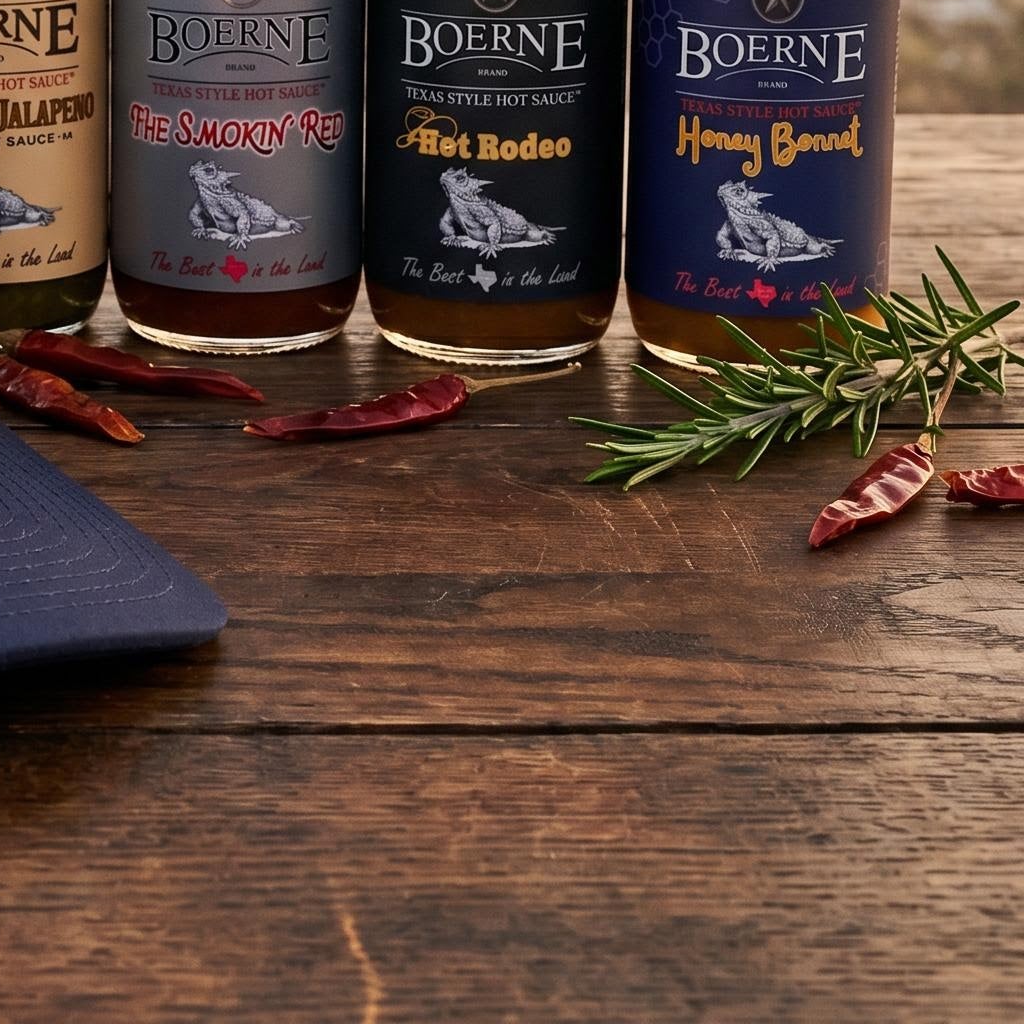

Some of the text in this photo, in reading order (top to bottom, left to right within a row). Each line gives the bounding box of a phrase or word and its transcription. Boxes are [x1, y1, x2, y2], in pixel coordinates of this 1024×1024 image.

[147, 10, 331, 67] BOERNE
[401, 15, 587, 71] BOERNE
[676, 26, 867, 84] BOERNE
[152, 82, 193, 99] TEXAS
[196, 87, 240, 101] STYLE
[244, 87, 275, 101] HOT
[405, 86, 444, 103] TEXAS
[447, 92, 492, 106] STYLE
[496, 94, 528, 106] HOT
[679, 97, 723, 116] TEXAS
[726, 103, 773, 119] STYLE
[778, 106, 810, 119] HOT
[407, 126, 572, 161] Hot Rodeo
[676, 114, 864, 178] Honey Bonnet
[150, 251, 173, 272] The
[270, 258, 291, 276] the
[401, 256, 424, 279] The
[520, 266, 543, 286] the
[674, 271, 697, 294] The
